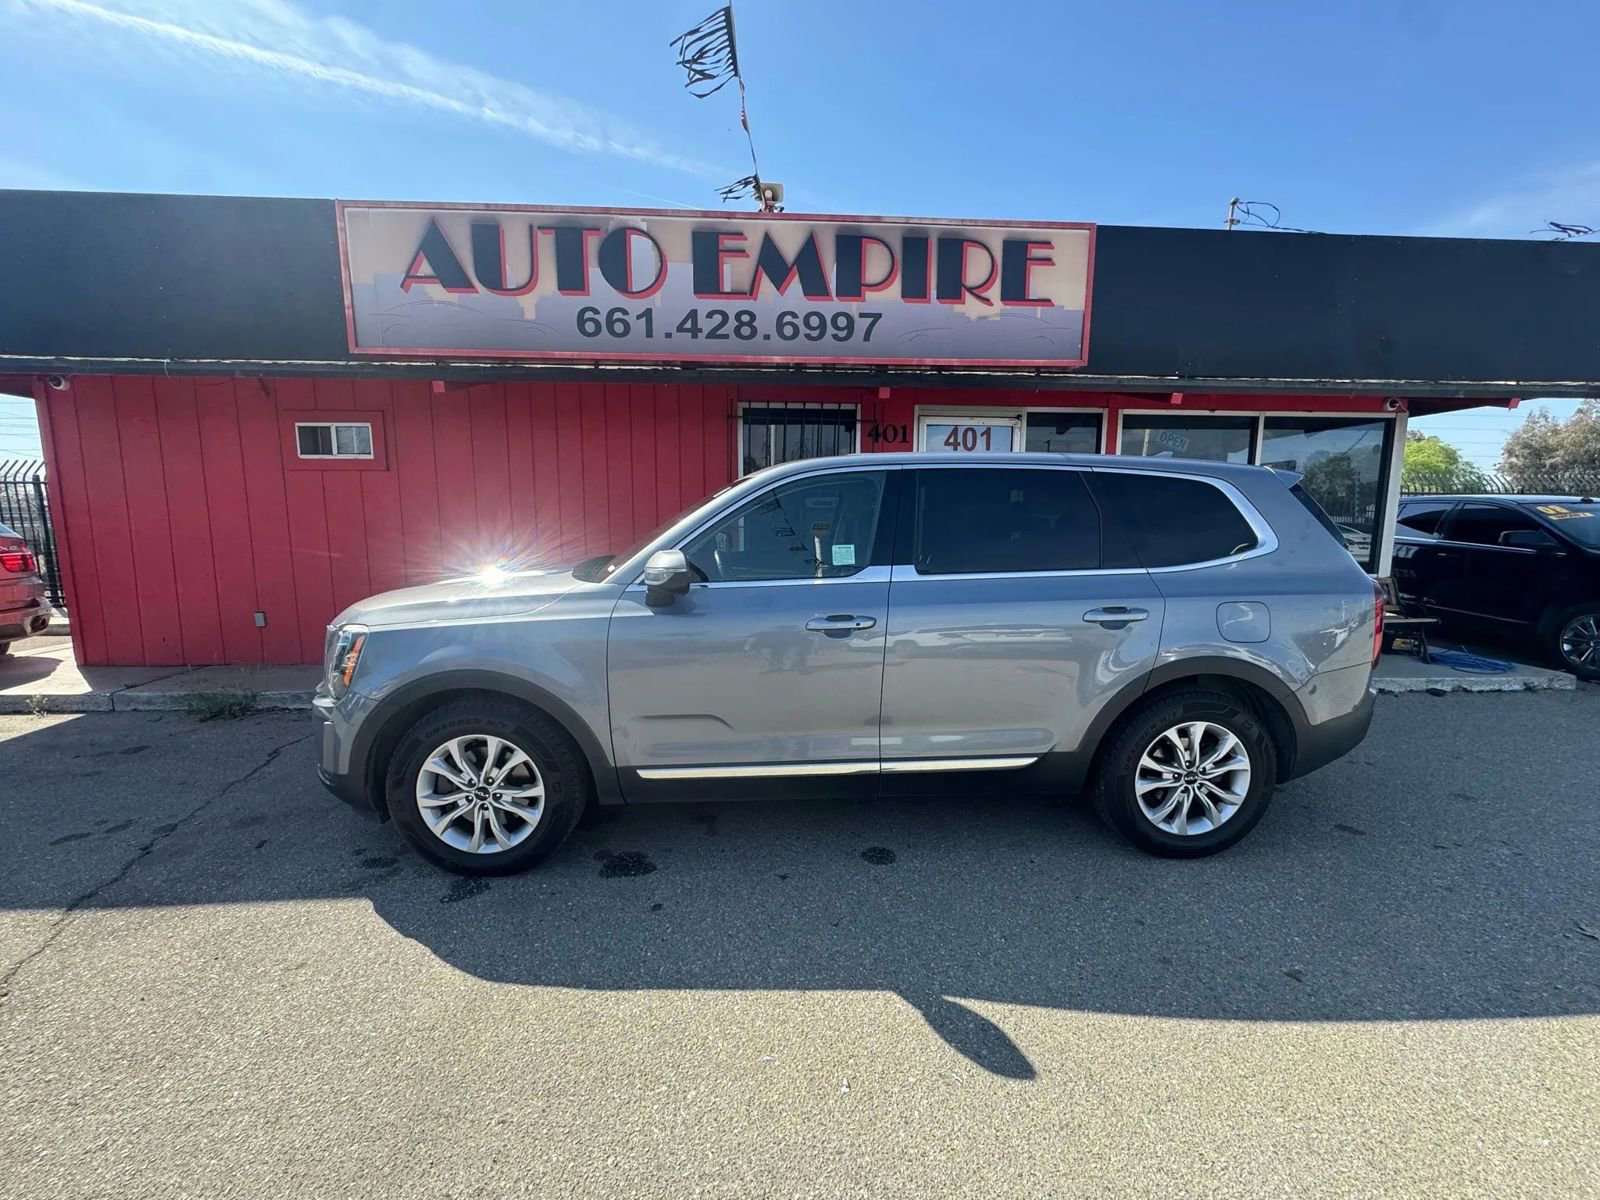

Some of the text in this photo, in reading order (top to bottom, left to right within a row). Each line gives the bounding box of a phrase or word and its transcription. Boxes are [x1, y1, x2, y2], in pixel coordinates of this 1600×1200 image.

[400, 217, 1056, 307] AUTO EMPIRE
[576, 306, 883, 342] 661.428.6997
[867, 424, 909, 443] 401
[944, 425, 991, 451] 401
